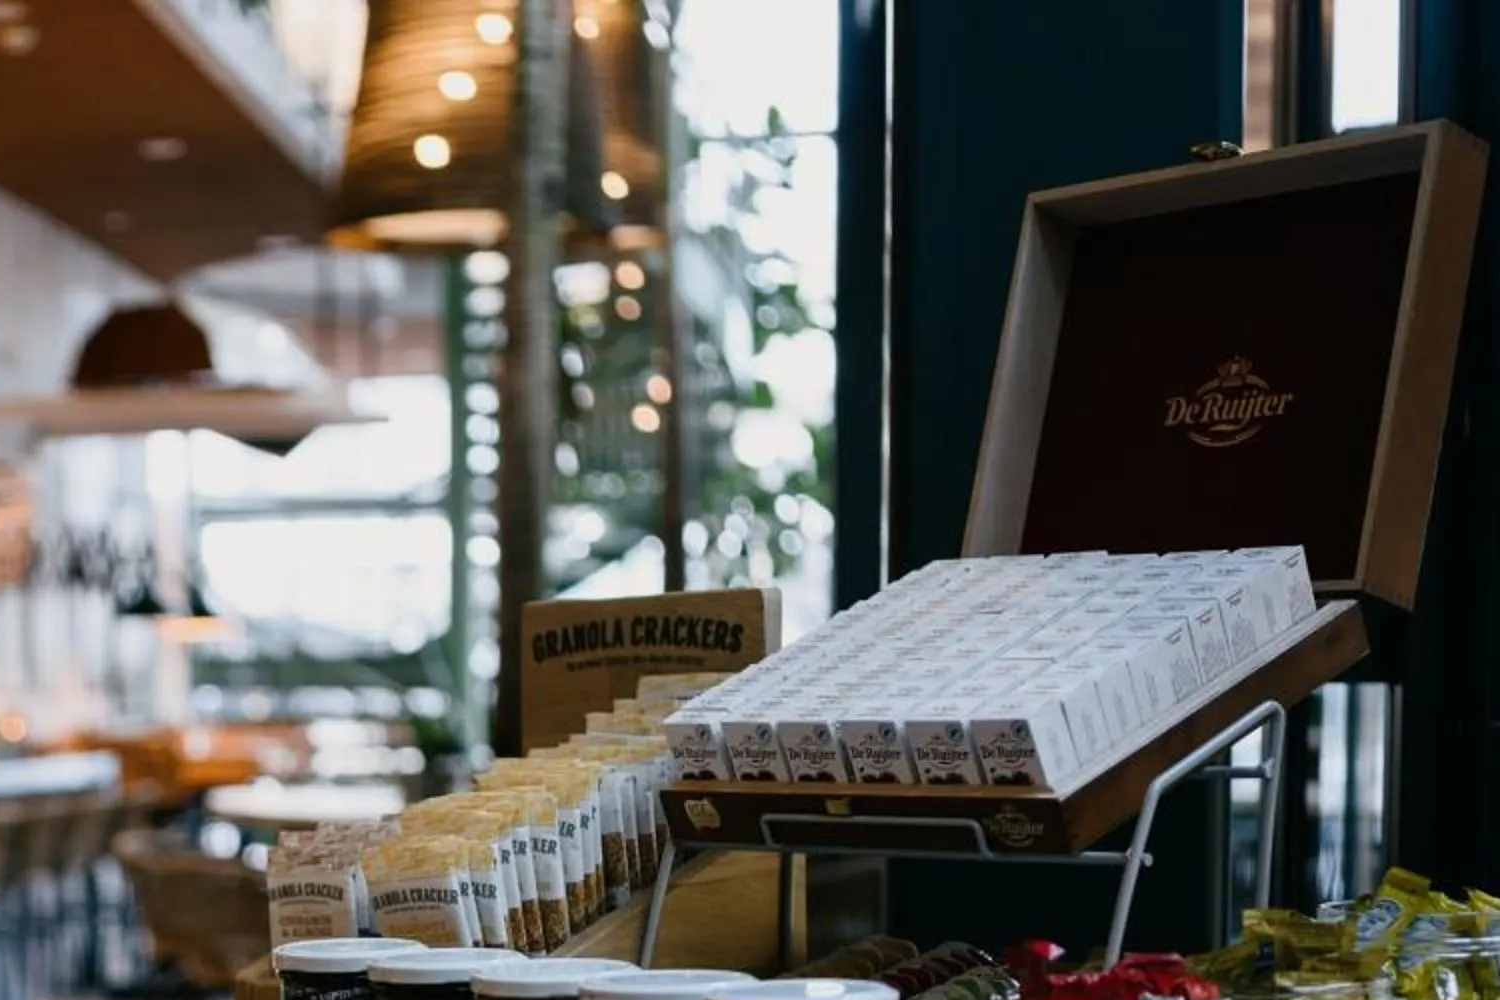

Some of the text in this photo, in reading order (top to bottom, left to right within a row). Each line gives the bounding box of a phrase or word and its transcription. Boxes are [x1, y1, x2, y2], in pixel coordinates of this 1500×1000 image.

[1200, 389, 1293, 428] Ruijter
[532, 618, 624, 664] GRANOLA
[631, 615, 744, 653] CRACKERS
